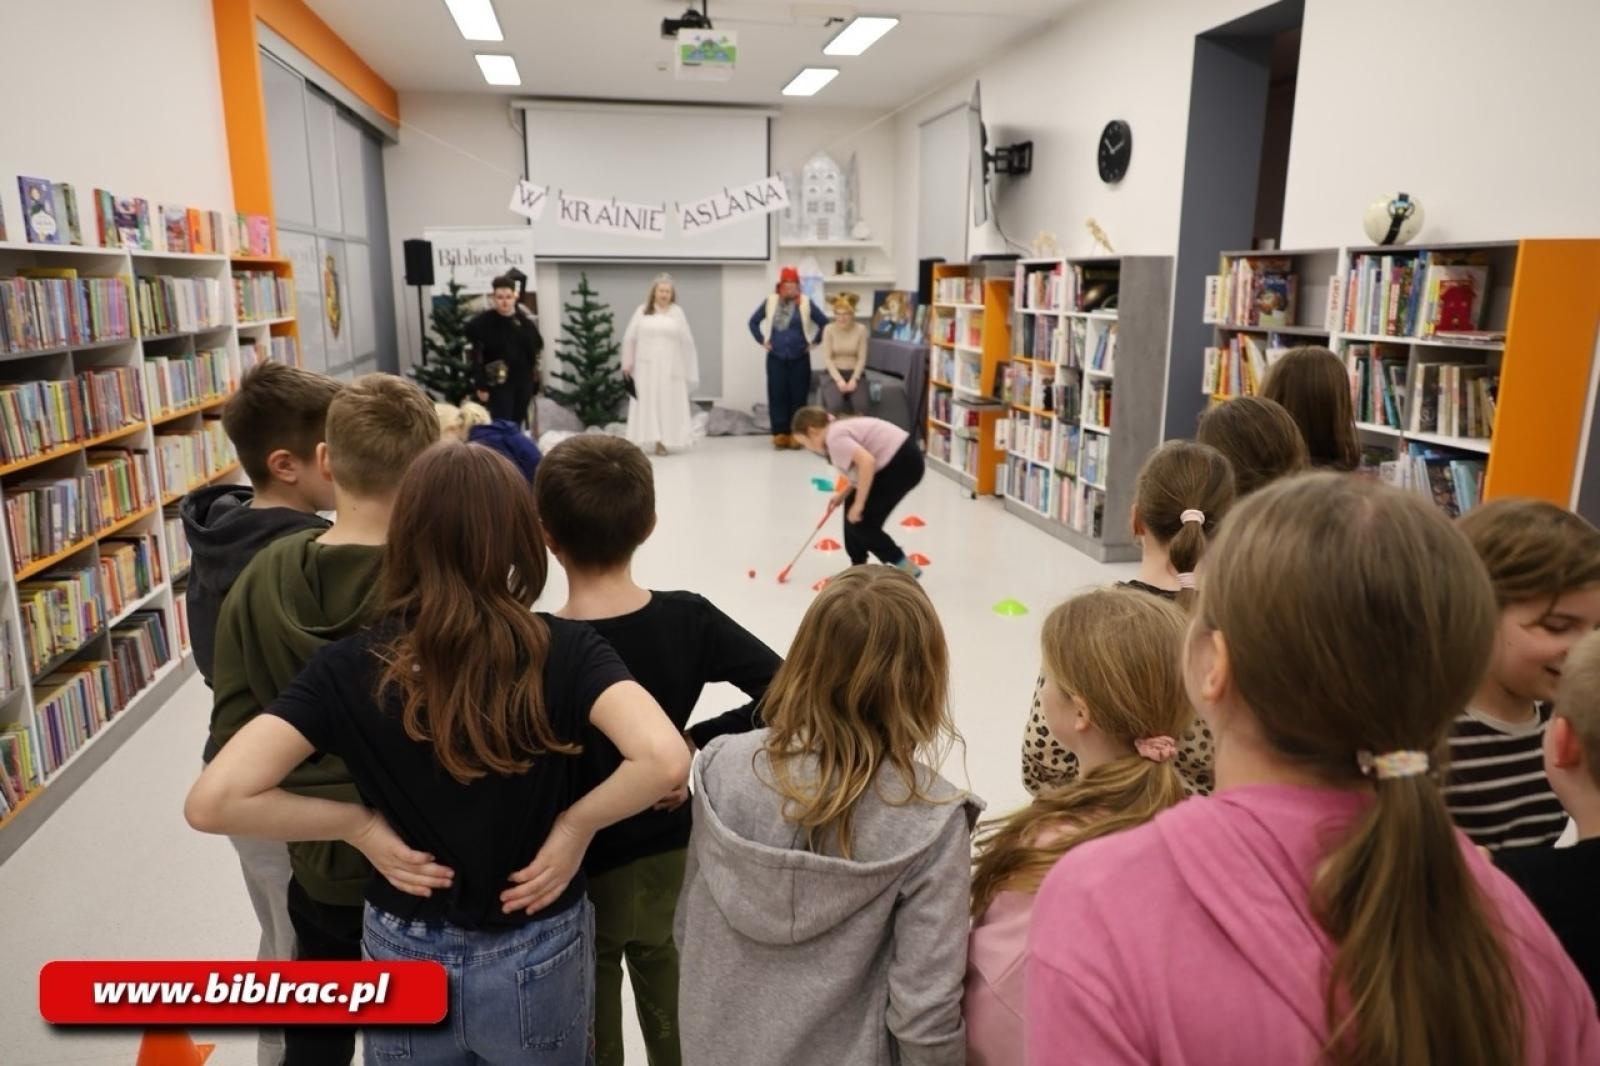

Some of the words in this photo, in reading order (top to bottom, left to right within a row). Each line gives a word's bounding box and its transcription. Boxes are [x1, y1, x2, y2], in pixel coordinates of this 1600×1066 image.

[518, 182, 545, 208] W
[560, 198, 663, 232] KRAINIE
[683, 183, 782, 230] ASLANA
[438, 247, 523, 267] Biblioteka
